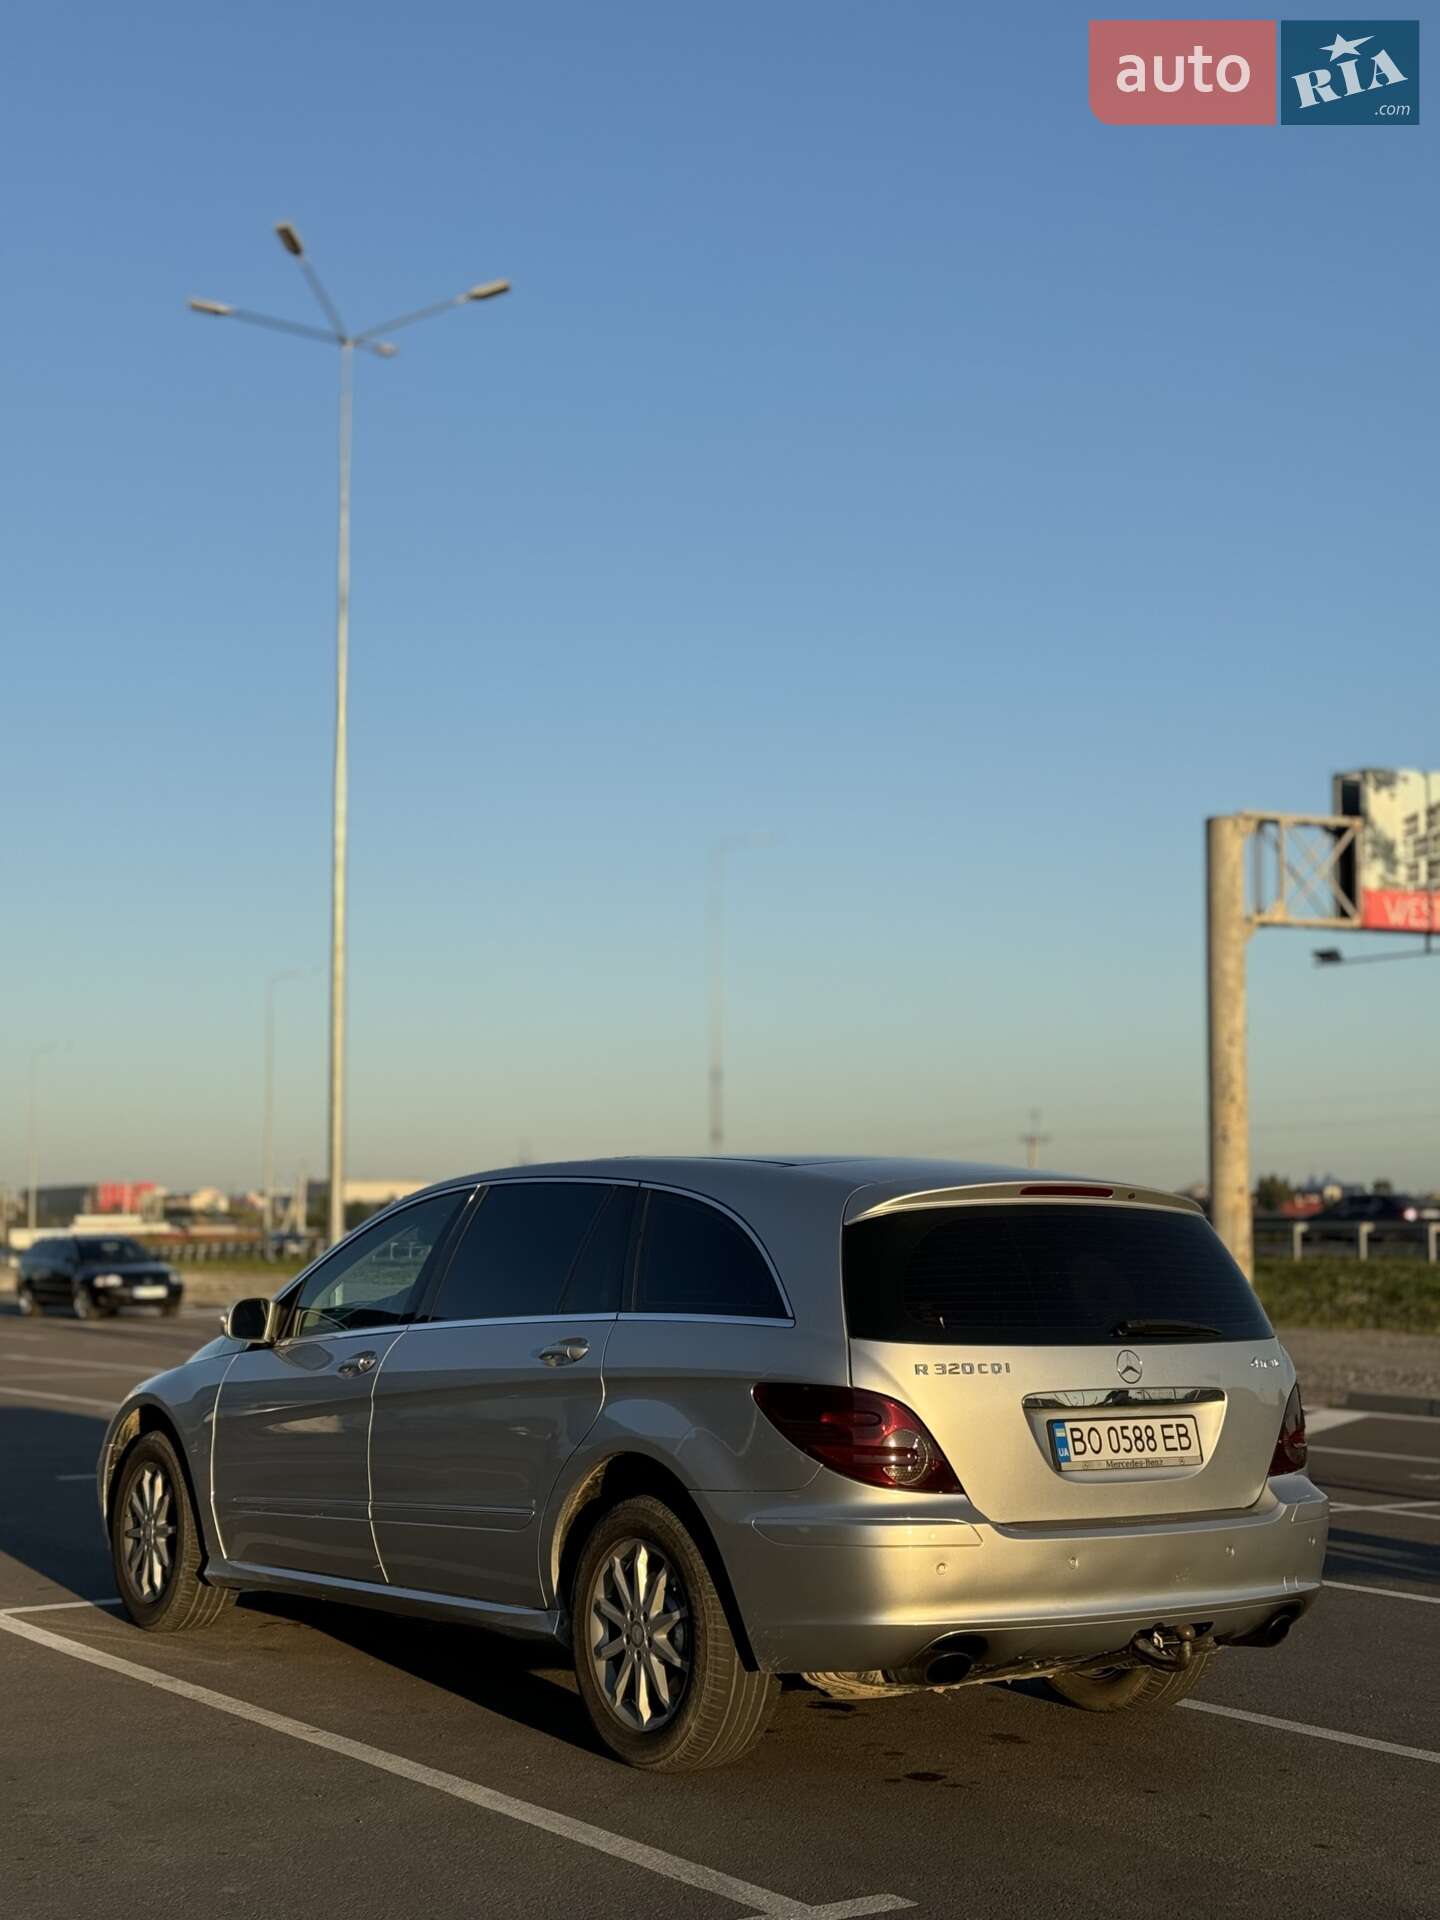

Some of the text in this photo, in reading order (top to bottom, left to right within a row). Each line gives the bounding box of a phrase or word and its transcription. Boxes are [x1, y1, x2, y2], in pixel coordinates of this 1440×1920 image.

[914, 1363, 929, 1375] R
[1070, 1423, 1192, 1456] BO 0588 EB
[1058, 1447, 1070, 1457] UA
[1105, 1459, 1163, 1469] Mercedes-Benz
